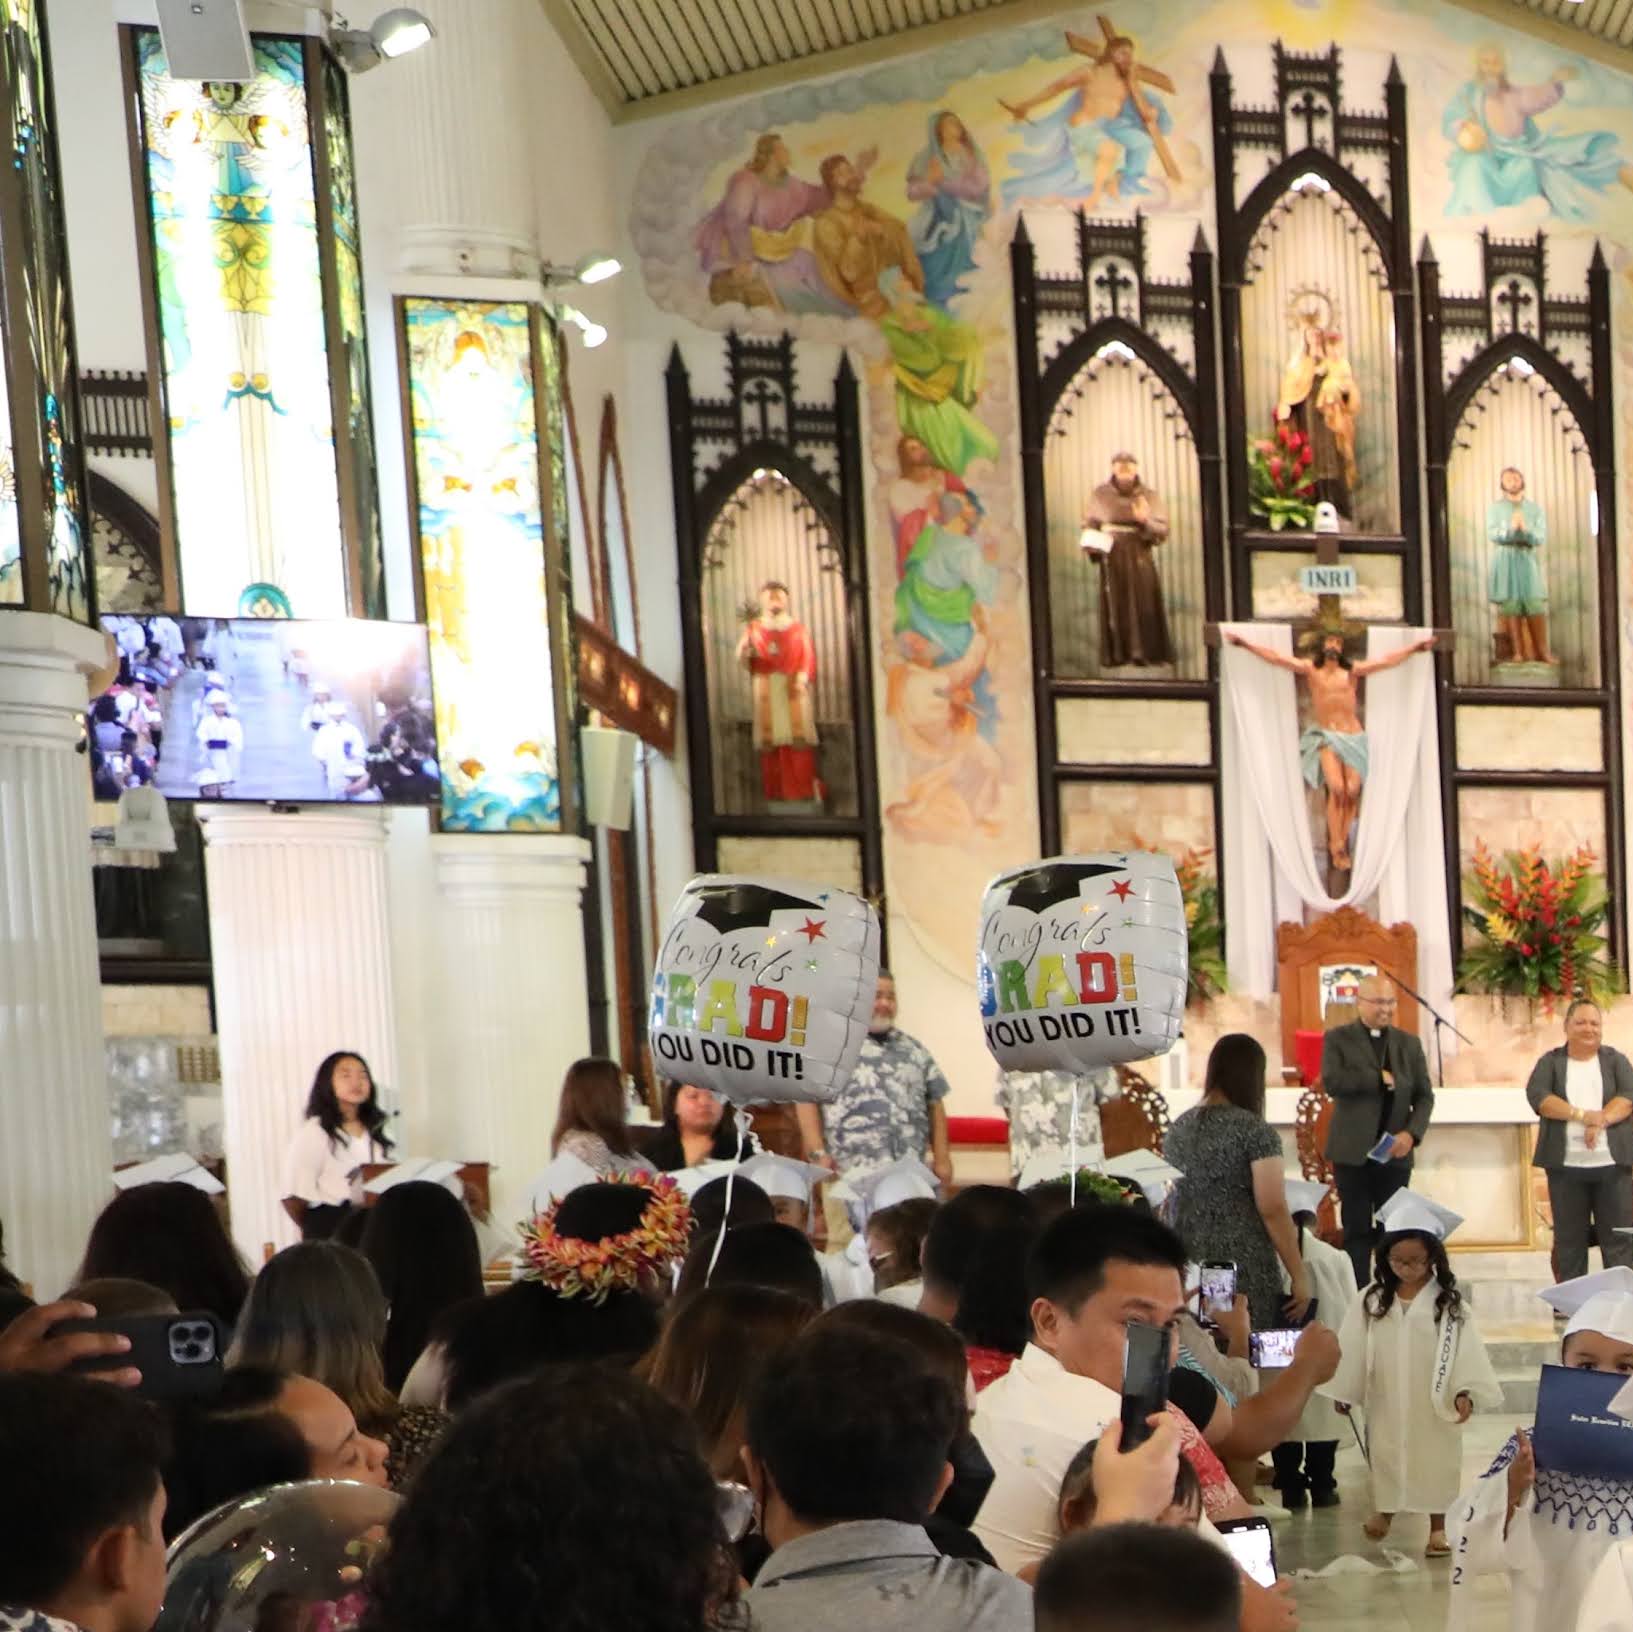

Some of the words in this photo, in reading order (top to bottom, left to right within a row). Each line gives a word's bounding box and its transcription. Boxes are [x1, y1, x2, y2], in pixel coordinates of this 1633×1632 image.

[1308, 569, 1350, 588] INRI
[660, 917, 793, 988] Congrats
[981, 910, 1112, 982] Congrats
[983, 1017, 1035, 1051] YOU
[1038, 1012, 1095, 1042] DID
[1105, 1007, 1142, 1037] IT!
[652, 1031, 695, 1062] OU
[700, 1038, 755, 1071] DID
[767, 1049, 804, 1081] IT!
